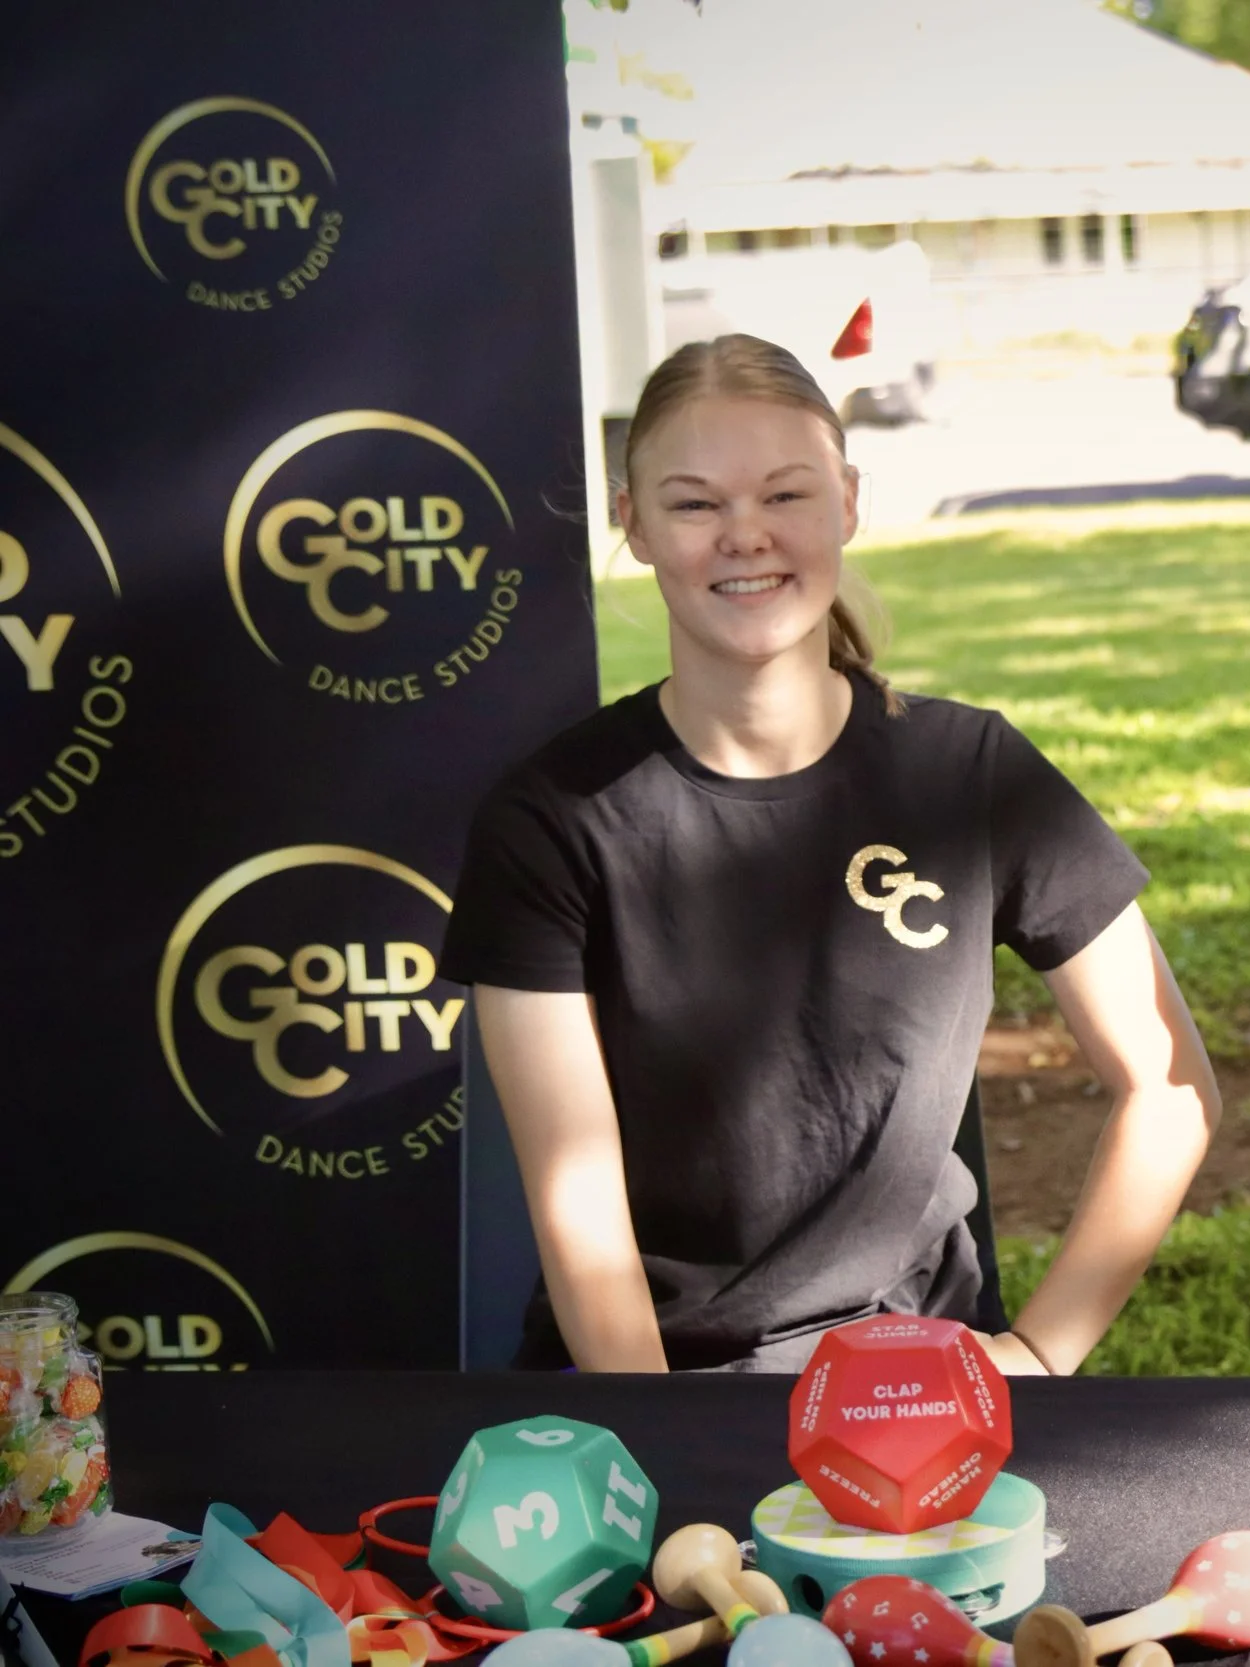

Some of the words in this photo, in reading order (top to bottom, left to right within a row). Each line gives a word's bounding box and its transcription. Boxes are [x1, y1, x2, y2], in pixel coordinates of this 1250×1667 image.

[149, 158, 300, 223] GOLD
[186, 195, 319, 260] CITY
[186, 282, 272, 312] DANCE
[277, 211, 344, 300] STUDIOS
[256, 496, 464, 583] GOLD
[307, 547, 489, 633] CITY
[308, 665, 424, 704] DANCE
[433, 568, 522, 688] STUDIOS
[194, 941, 436, 1041] GOLD
[253, 999, 465, 1098] CITY
[254, 1134, 390, 1179] DANCE
[76, 1314, 222, 1361] OLD
[864, 1330, 928, 1338] JUMPS
[871, 1324, 919, 1332] STAR
[873, 1383, 923, 1399] CLAP
[954, 1337, 975, 1381] YOUR
[974, 1386, 994, 1428] TOES
[969, 1352, 995, 1410] TOUCH
[841, 1406, 891, 1421] YOUR
[896, 1400, 957, 1418] HANDS
[819, 1465, 881, 1508] FREEZE
[932, 1466, 982, 1509] HANDS
[959, 1452, 981, 1472] ON
[919, 1471, 958, 1507] HEAD
[493, 1491, 560, 1549] 3
[451, 1571, 503, 1612] 4
